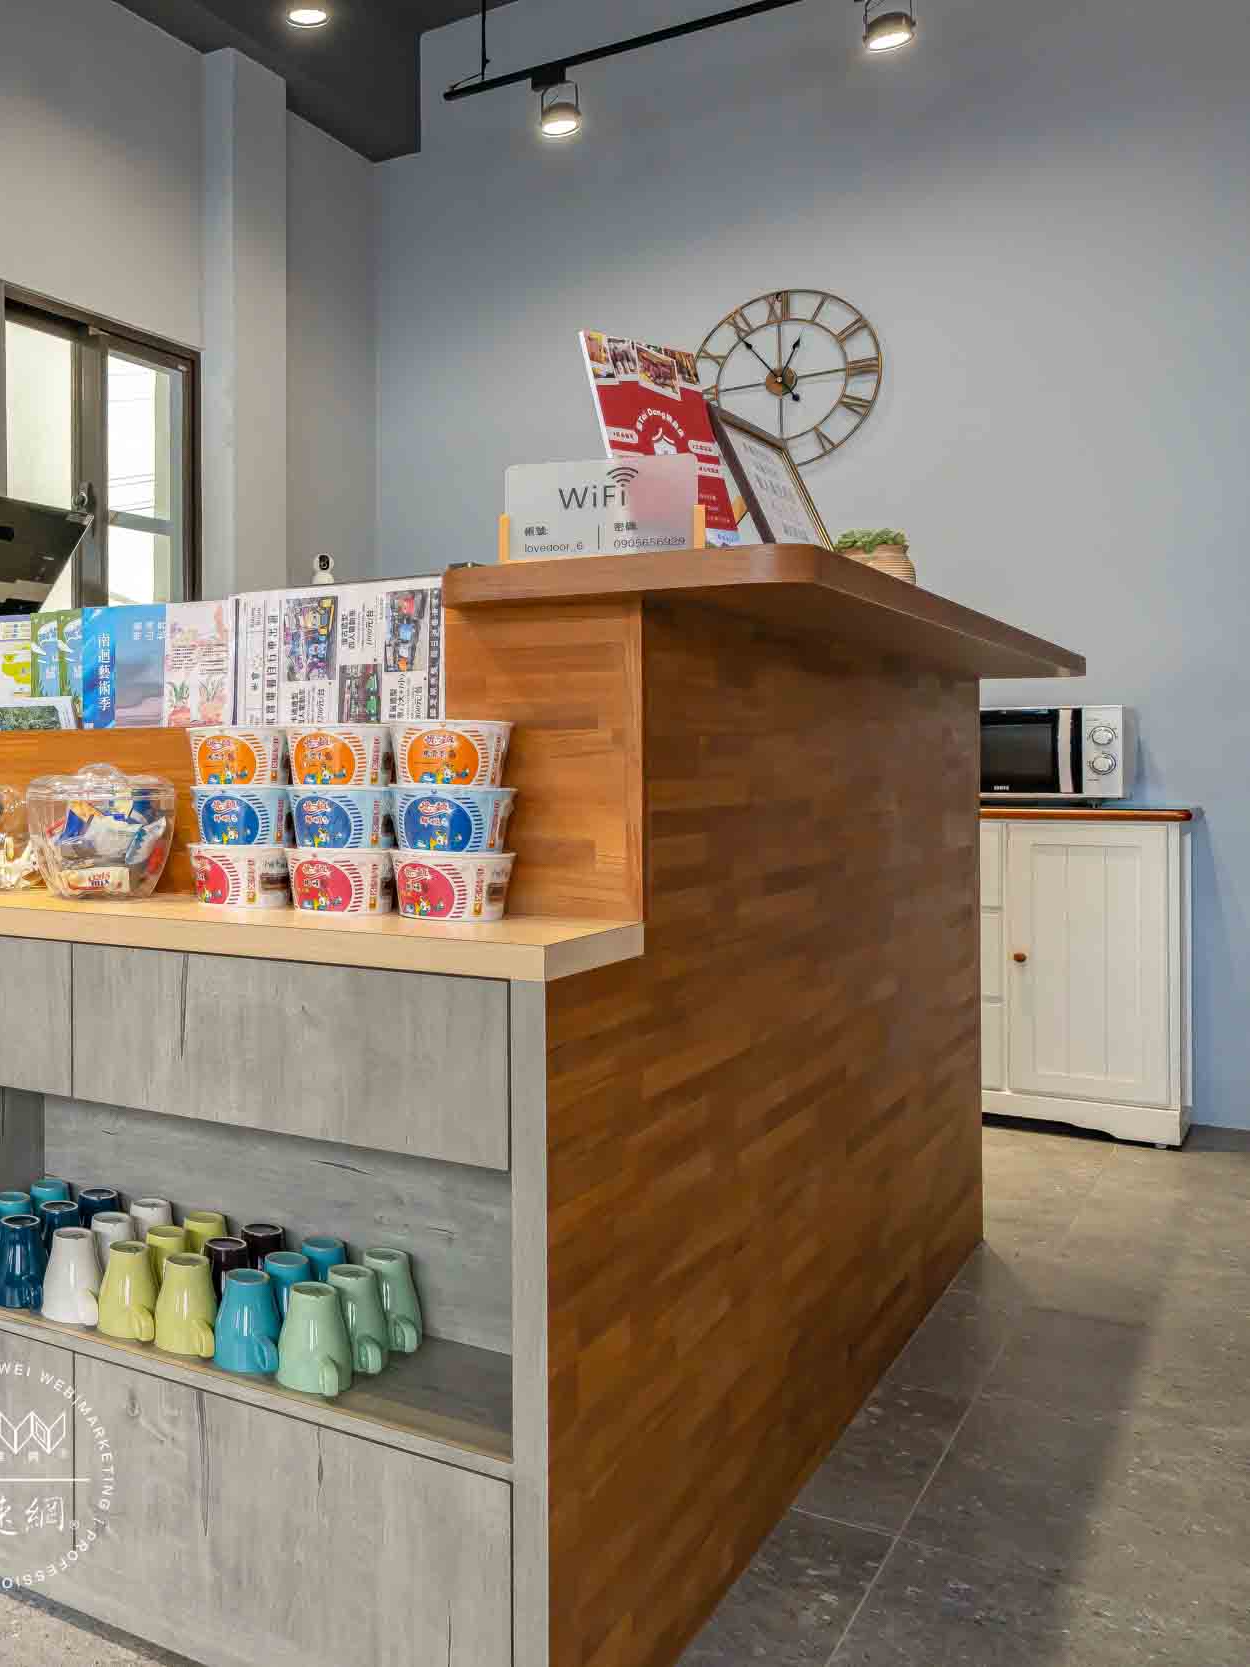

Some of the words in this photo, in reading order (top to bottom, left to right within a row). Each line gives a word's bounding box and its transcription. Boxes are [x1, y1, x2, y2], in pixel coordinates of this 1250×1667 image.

[558, 484, 626, 510] WiFi
[98, 632, 111, 711] 南迴藝術季
